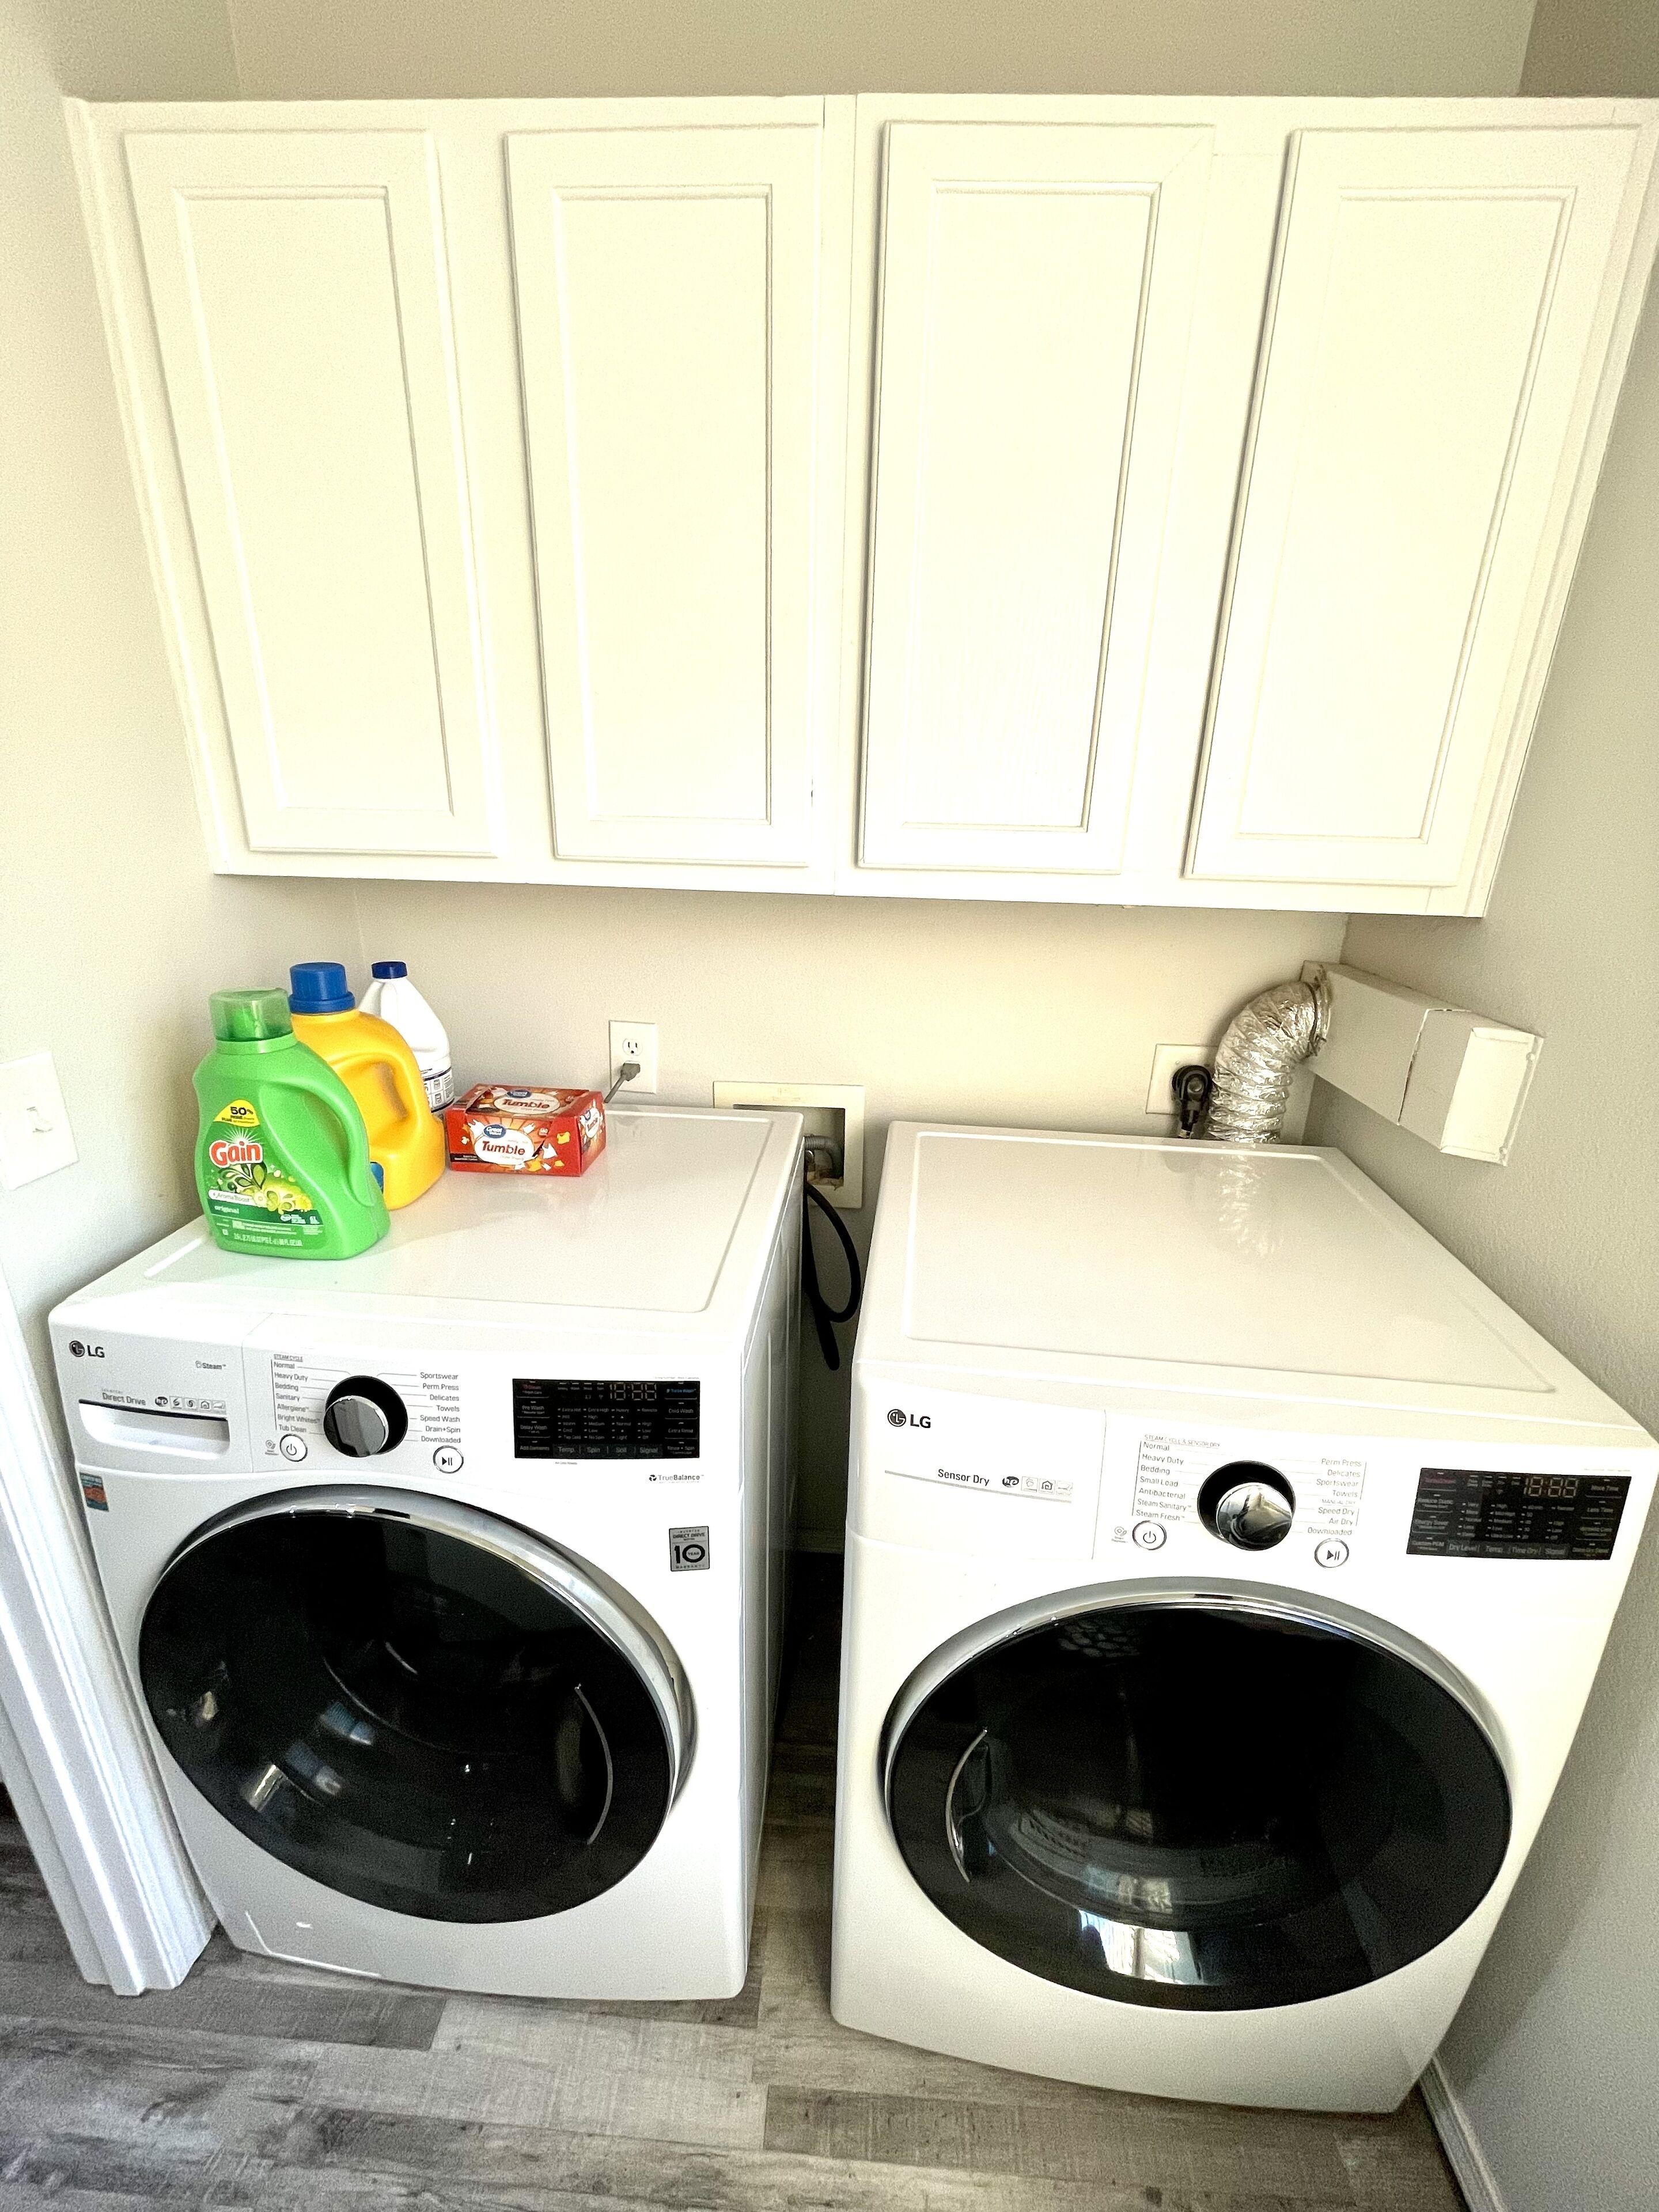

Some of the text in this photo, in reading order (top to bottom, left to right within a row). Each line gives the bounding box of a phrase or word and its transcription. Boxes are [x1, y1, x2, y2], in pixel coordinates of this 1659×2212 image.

[502, 1099, 550, 1109] Tumble
[482, 1141, 525, 1156] Tumble
[210, 1141, 262, 1167] Gain
[214, 1206, 240, 1214] original
[87, 1344, 105, 1358] LG
[274, 1372, 293, 1380] Heavy
[275, 1382, 299, 1391] Bedding
[102, 1392, 146, 1406] Direct Drive
[276, 1393, 300, 1402] Sanitary
[910, 1414, 931, 1429] LG
[1143, 1441, 1169, 1451] Normal
[1142, 1453, 1184, 1465] Heavy Duty
[1141, 1464, 1170, 1475] Bedding
[1327, 1469, 1361, 1478] Delicates
[938, 1468, 990, 1487] Sensor Dry
[1140, 1476, 1179, 1487] Small Load
[1316, 1478, 1358, 1486] Sportswear
[1138, 1487, 1185, 1499] Antibacterial
[1137, 1498, 1158, 1506] Steam
[1136, 1509, 1158, 1518] Steam
[1308, 1527, 1353, 1535] Downloaded
[674, 1544, 706, 1564] 10
